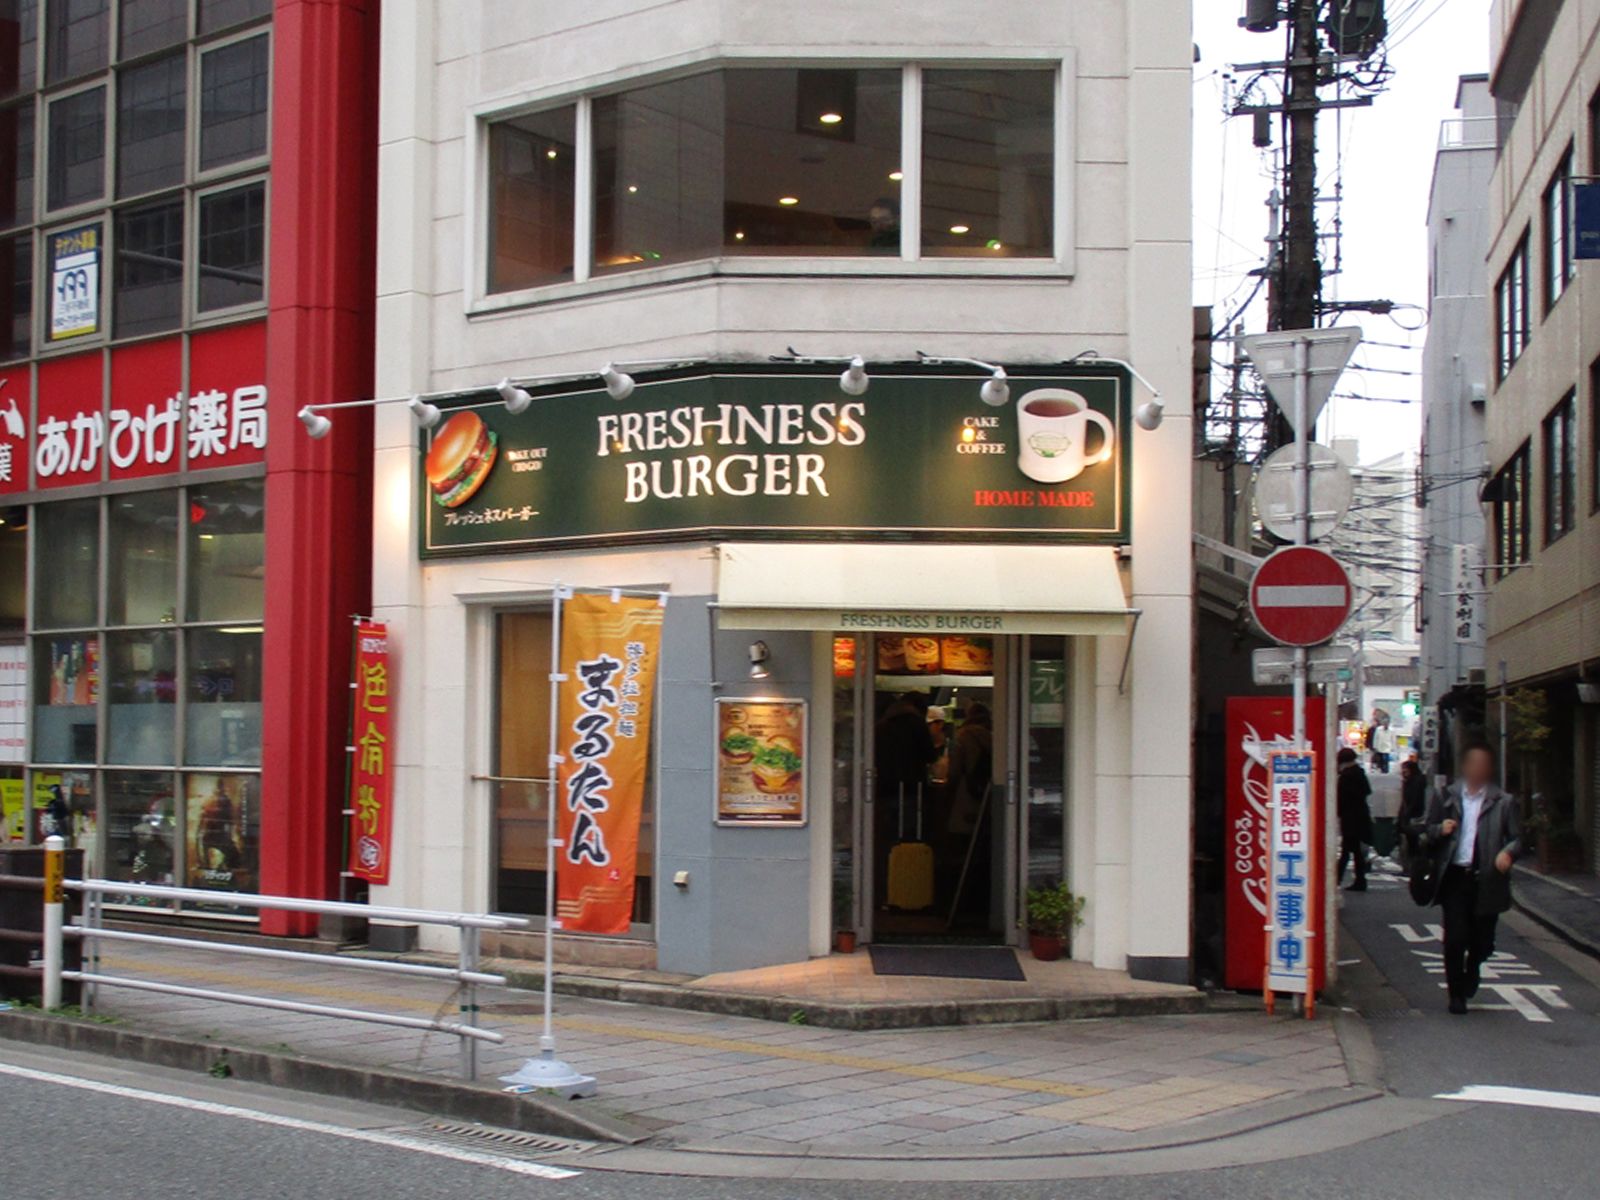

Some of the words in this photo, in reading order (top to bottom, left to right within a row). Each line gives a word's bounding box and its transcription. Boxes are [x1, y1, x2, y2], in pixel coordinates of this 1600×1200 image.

[36, 385, 267, 477] あかひげ薬局
[597, 402, 866, 457] FRESHNESS
[963, 417, 999, 429] CAKE
[976, 430, 986, 440] &
[957, 442, 1006, 454] COFFEE
[625, 456, 830, 503] BURGER
[974, 490, 1034, 507] HOME
[1037, 490, 1094, 507] MADE
[841, 613, 929, 630] FRESHNESS
[936, 614, 1003, 630] BURGER
[568, 656, 620, 865] まるたん
[1276, 850, 1305, 971] 工事中
